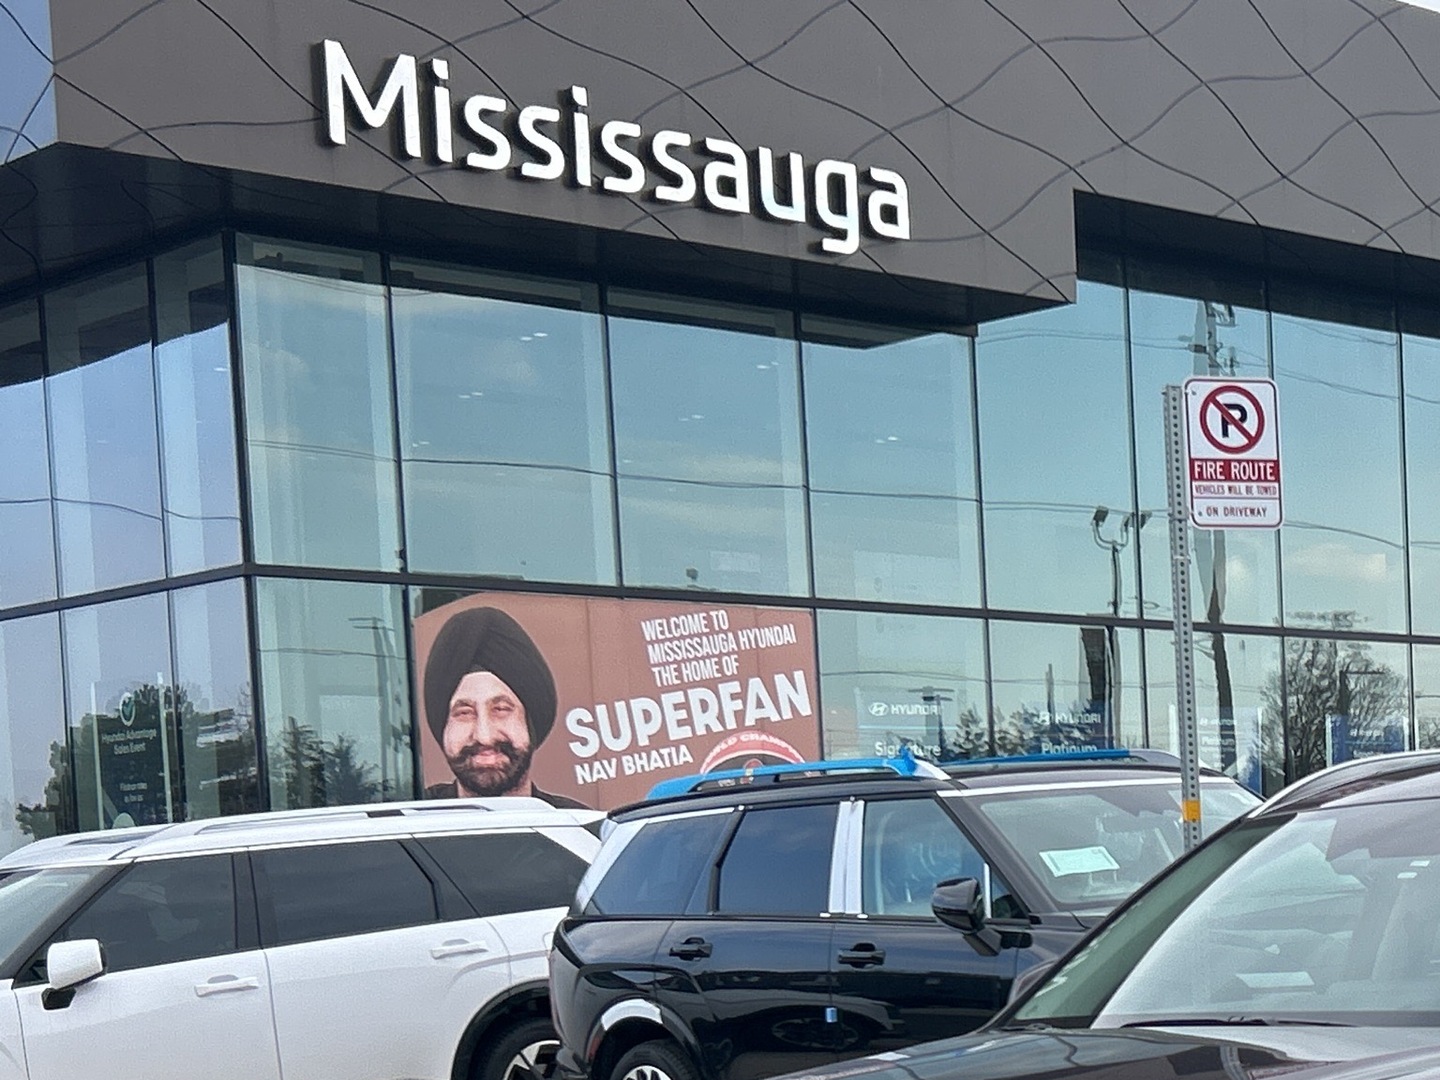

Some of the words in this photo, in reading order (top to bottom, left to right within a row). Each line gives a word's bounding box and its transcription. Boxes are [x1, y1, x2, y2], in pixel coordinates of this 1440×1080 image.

[323, 38, 911, 255] Mississauga
[1194, 461, 1226, 480] FIRE
[1231, 461, 1276, 480] ROUTE
[1206, 507, 1219, 516] ON
[1223, 507, 1268, 517] DRIVEWAY
[641, 613, 710, 641] WELCOME
[710, 609, 729, 631] TO
[647, 631, 739, 665] MISSISSAUGA
[739, 623, 797, 650] HYUNDAI
[651, 665, 679, 687] THE
[682, 659, 721, 683] HOME
[723, 654, 739, 675] OF
[565, 670, 813, 758] SUPERFAN
[575, 757, 617, 785] NAV
[622, 744, 694, 780] BHATIA
